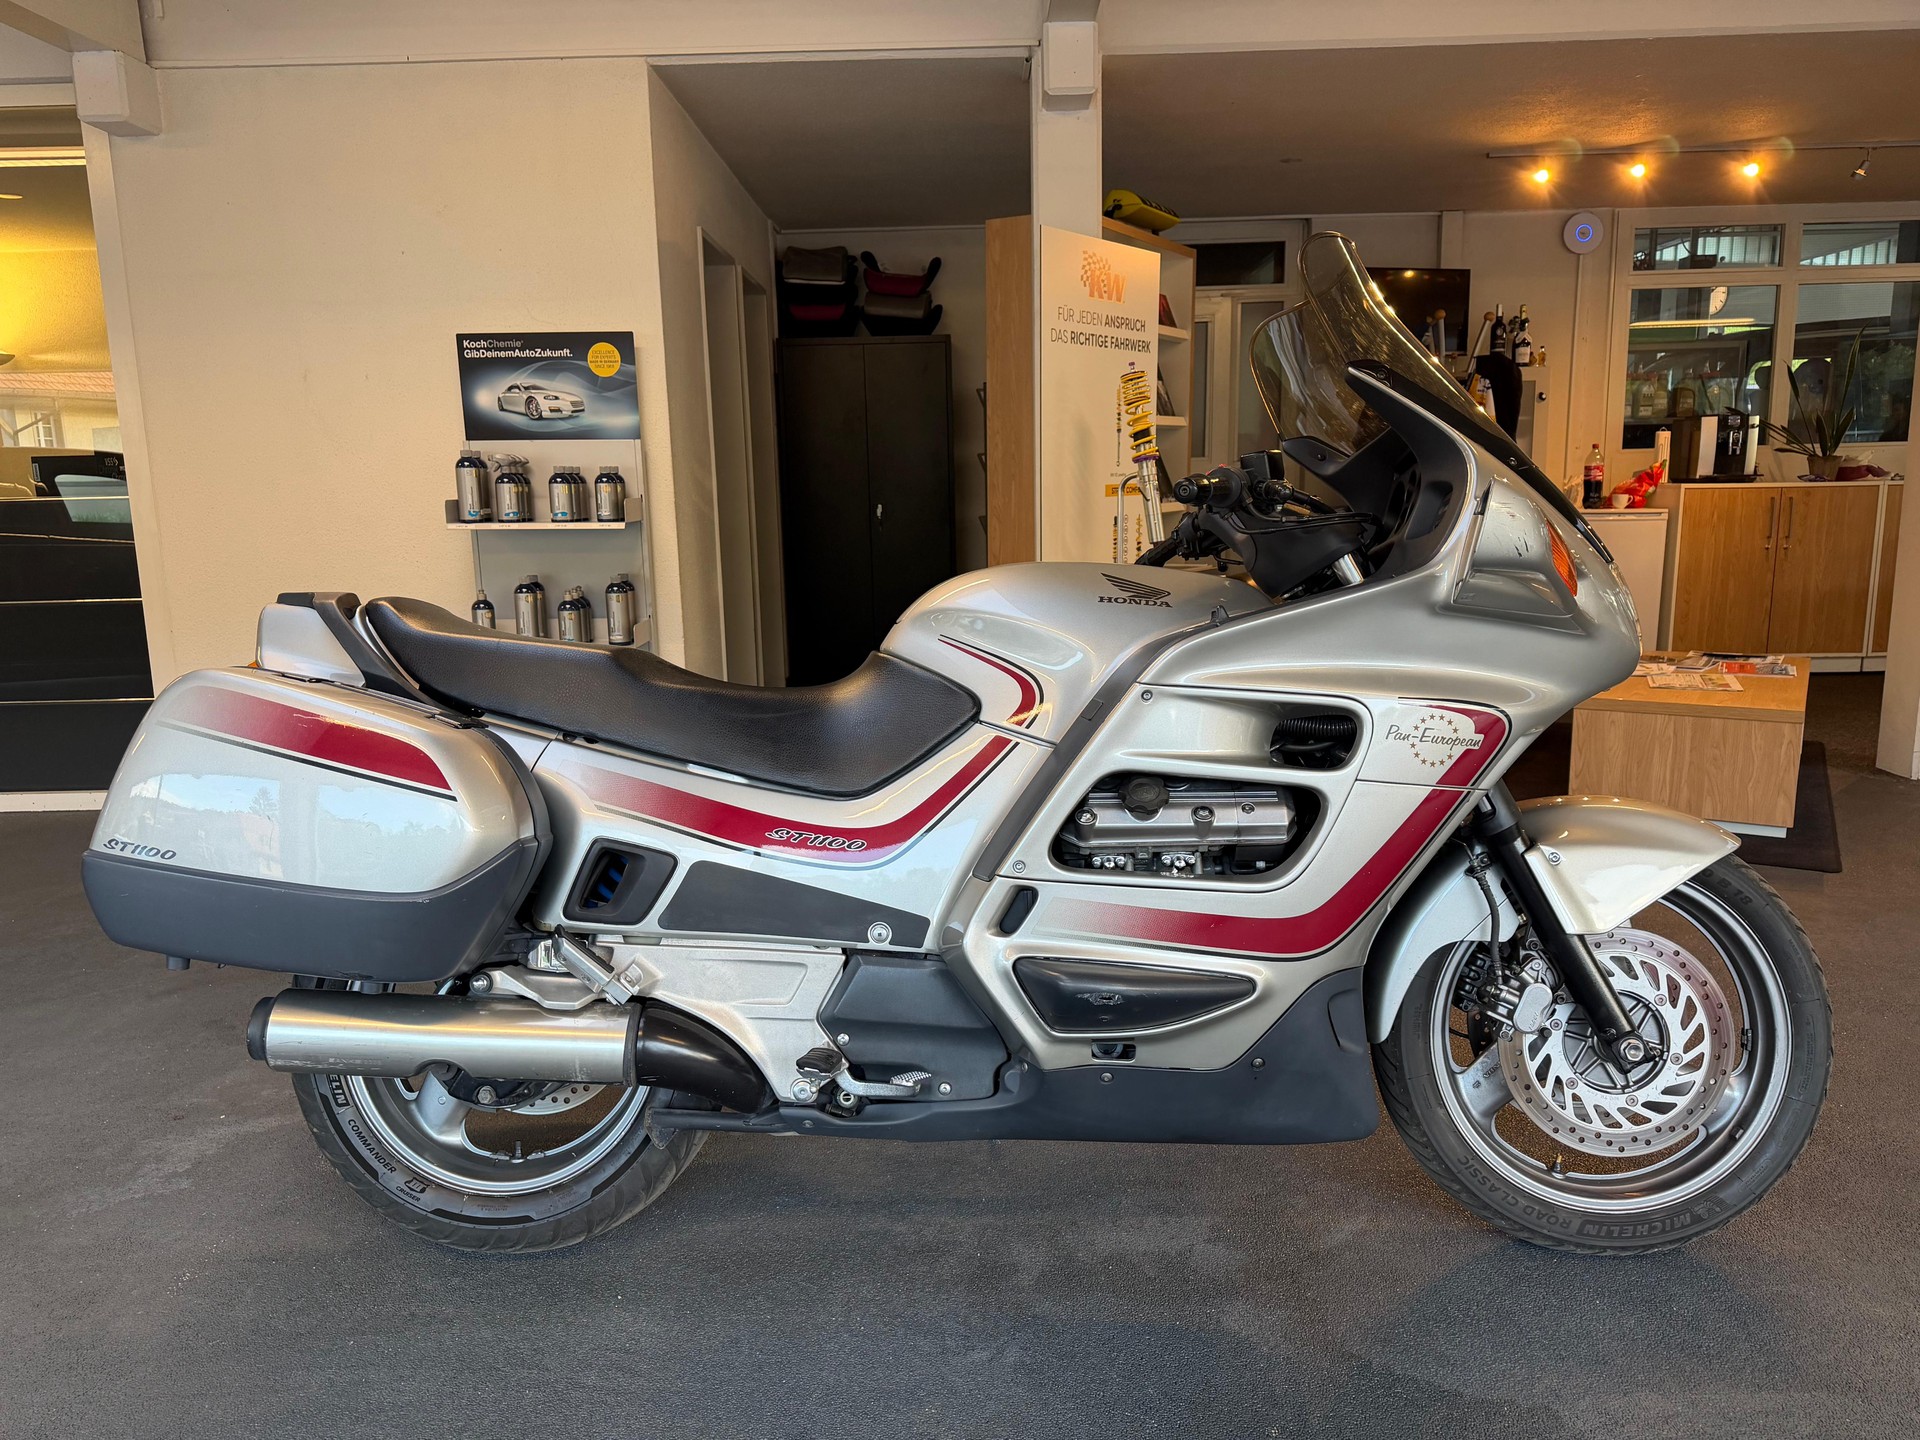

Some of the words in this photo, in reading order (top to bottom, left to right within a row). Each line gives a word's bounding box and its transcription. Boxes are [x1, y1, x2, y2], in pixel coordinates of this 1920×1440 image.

[1088, 268, 1127, 304] KW
[1057, 305, 1075, 323] FÜR
[1077, 310, 1103, 328] JEDEN
[1104, 314, 1146, 333] ANSPRUCH
[464, 349, 573, 359] GibDeinemAutoZukunft.
[1050, 328, 1069, 344] DAS
[1070, 331, 1109, 349] RICHTIGE
[1110, 336, 1152, 354] FAHRWERK
[1098, 596, 1173, 608] HONDA
[1385, 724, 1482, 751] Pan-European
[103, 838, 177, 860] ST1100
[765, 828, 867, 851] ST1100
[347, 1118, 397, 1174] COMMANDER
[395, 1185, 421, 1203] CRUISER
[1456, 1155, 1519, 1207] CLASSIC
[1523, 1203, 1573, 1230] ROAD
[1583, 1212, 1692, 1238] MICHELIN
